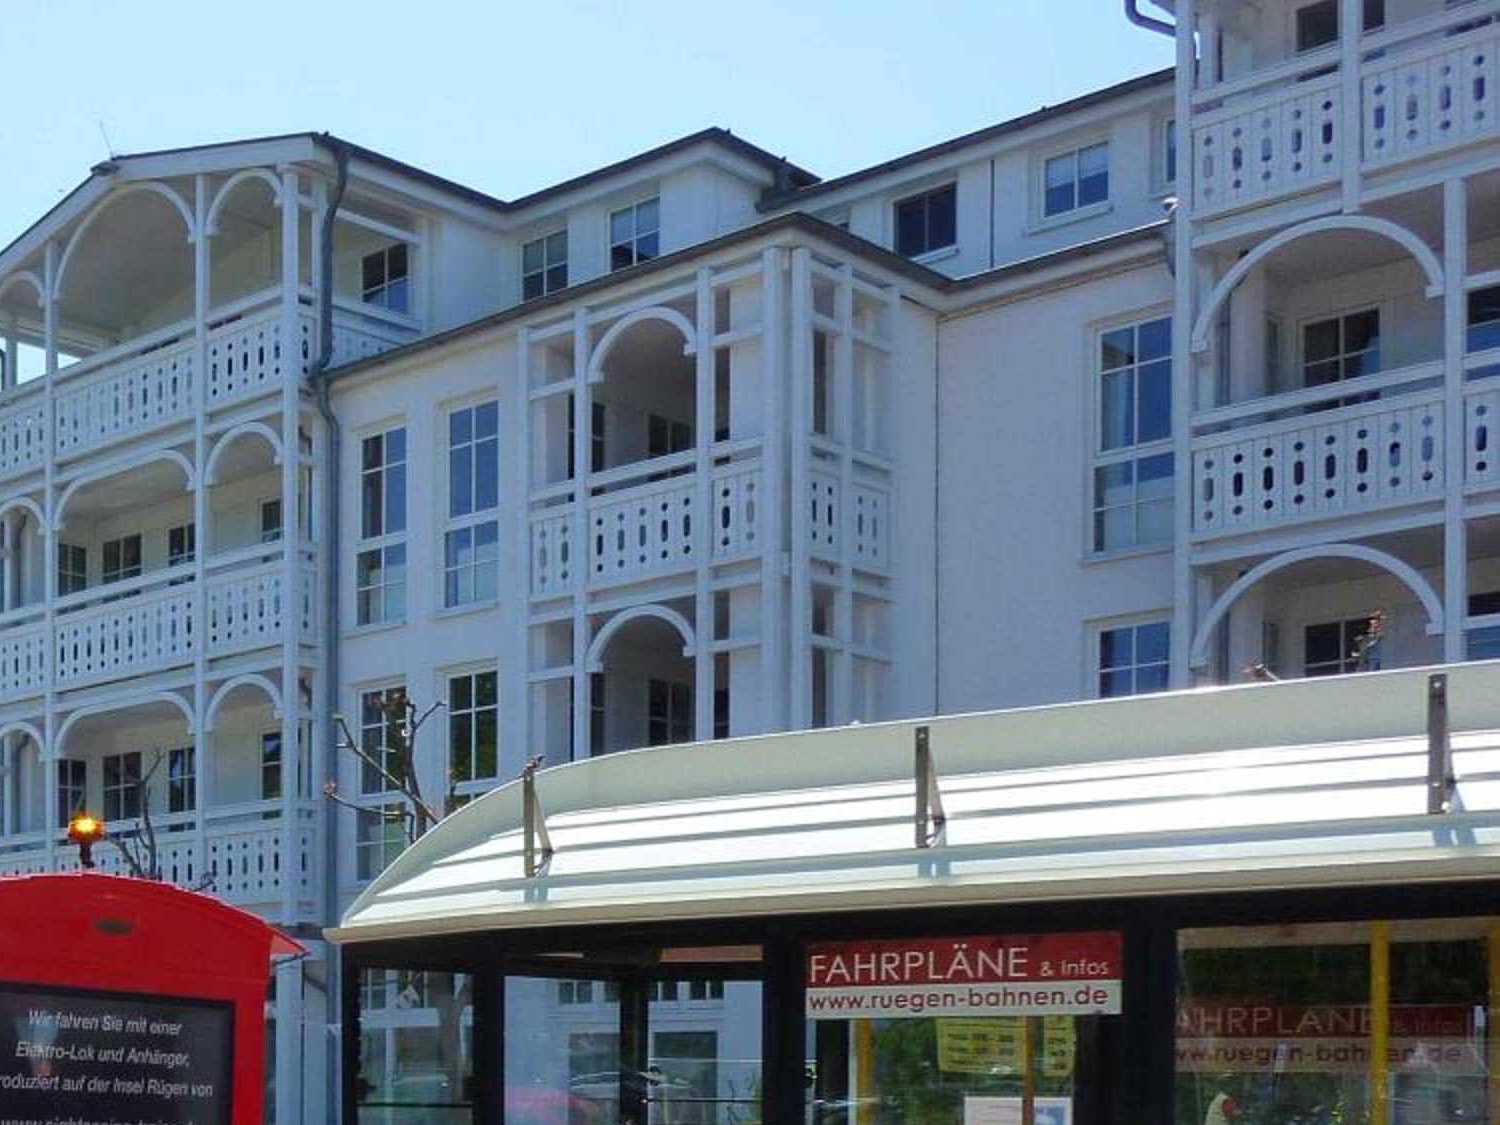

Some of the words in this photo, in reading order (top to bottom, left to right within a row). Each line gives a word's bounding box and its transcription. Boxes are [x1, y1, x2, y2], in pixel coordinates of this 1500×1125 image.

[810, 943, 1028, 983] FAHRPLÄNE
[1040, 960, 1054, 976] &
[810, 985, 1108, 1012] www.ruegen-bahnen.de
[28, 1009, 53, 1028] Wir
[54, 1011, 99, 1031] fahren
[102, 1014, 124, 1032] Sie
[126, 1016, 148, 1034] mit
[150, 1019, 183, 1036] einer
[15, 1041, 95, 1062] Elektro-Lok
[97, 1046, 124, 1064] und
[127, 1047, 191, 1070] Anhänger,
[62, 1076, 85, 1092] auf
[87, 1078, 111, 1093] der
[113, 1078, 145, 1095] Insel
[147, 1079, 189, 1099] Rügen
[191, 1083, 214, 1098] von
